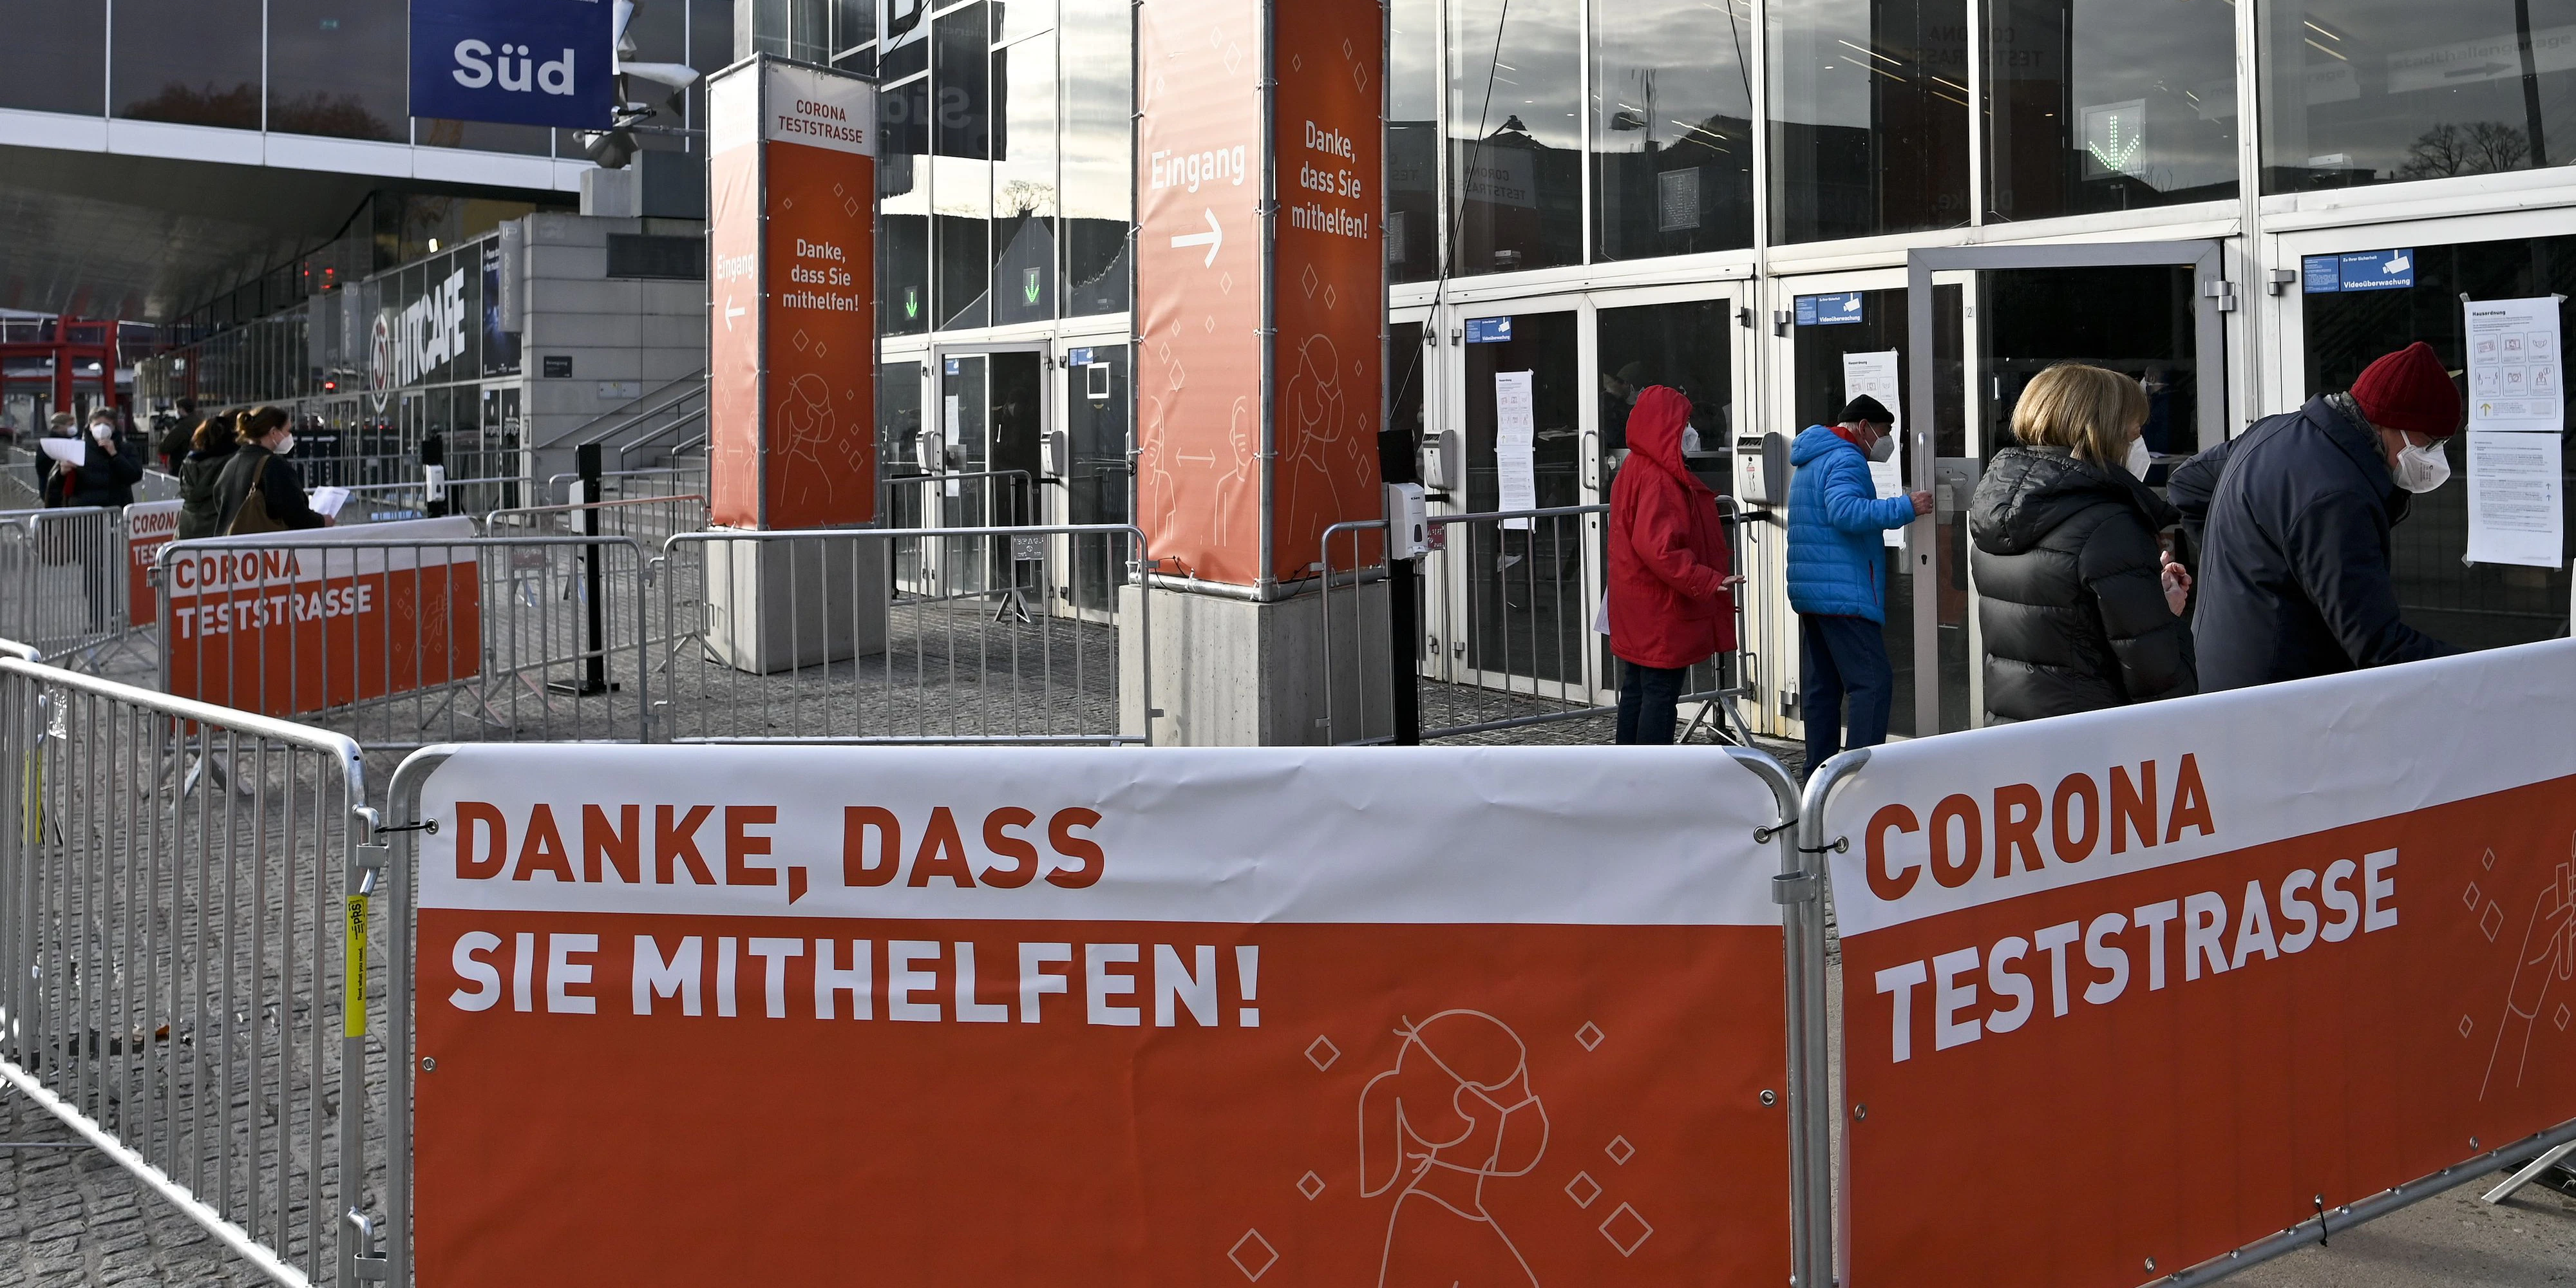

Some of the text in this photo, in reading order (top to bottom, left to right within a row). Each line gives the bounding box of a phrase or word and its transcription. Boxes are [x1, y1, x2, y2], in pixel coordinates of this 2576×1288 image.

[452, 39, 575, 96] Süd
[779, 115, 863, 144] TESTSTRASSE
[797, 99, 847, 122] CORONA
[1305, 120, 1356, 165] Danke,
[1151, 145, 1245, 193] Eingang
[1300, 161, 1334, 194] dass
[1338, 167, 1361, 199] Sie
[1292, 202, 1368, 240] mithelfen!
[717, 252, 754, 283] Eingang
[797, 238, 846, 263] Danke,
[791, 265, 851, 286] dass Sie
[2344, 278, 2410, 289] Videoüberwachung
[783, 290, 859, 312] mithelfen!
[1967, 307, 1973, 317] 2
[394, 267, 465, 388] HITCAFE
[176, 549, 301, 589] CORONA
[176, 583, 372, 639] TESTSTRASSE
[1864, 753, 2215, 901] CORONA
[455, 801, 1105, 905] DANKE, DASS
[1874, 848, 2398, 1064] TESTSTRASSE
[448, 931, 1260, 1027] SIE MITHELFEN!
